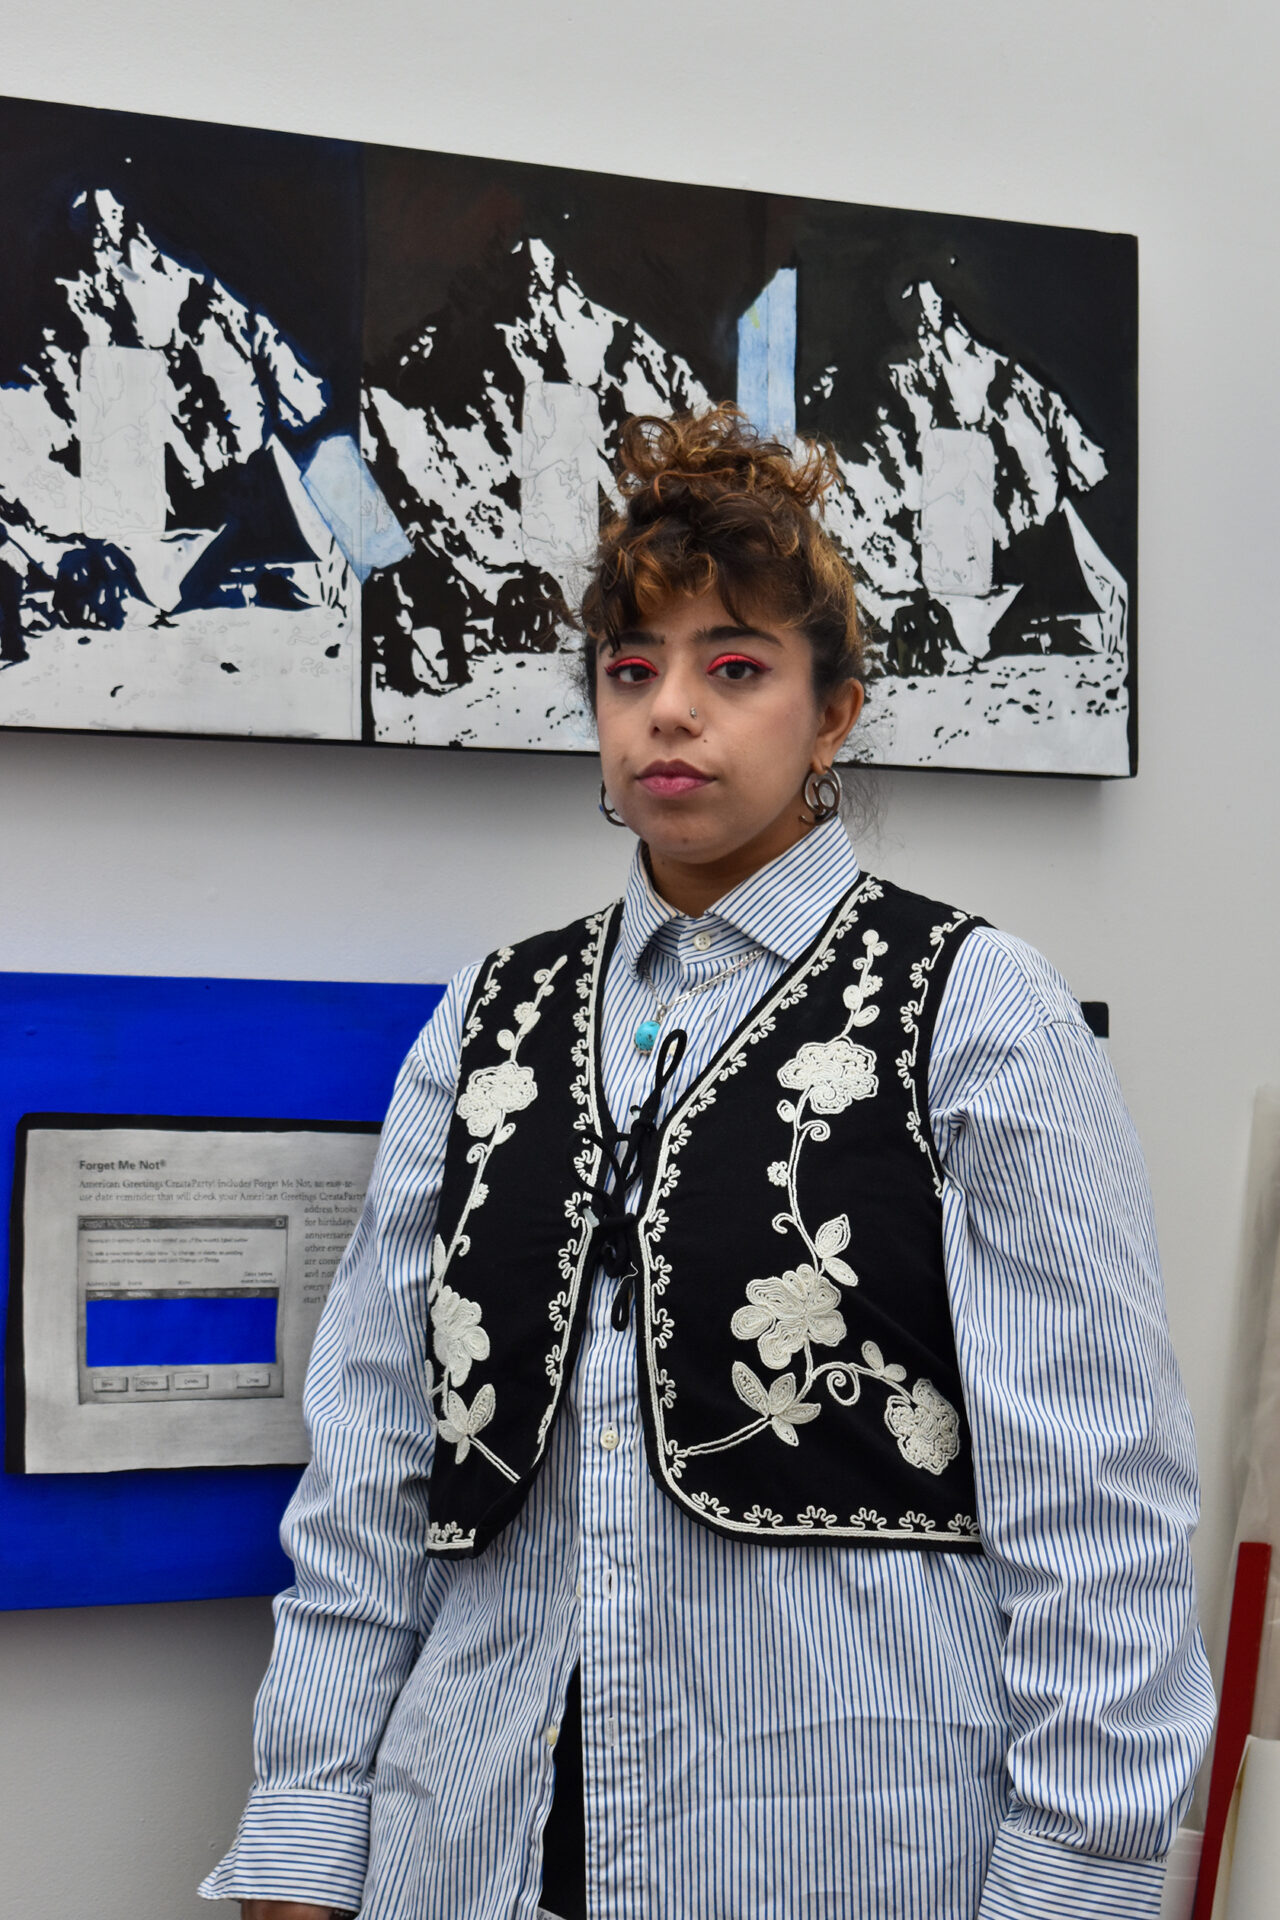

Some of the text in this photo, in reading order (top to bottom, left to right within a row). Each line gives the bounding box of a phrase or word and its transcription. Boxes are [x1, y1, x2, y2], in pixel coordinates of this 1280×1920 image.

[79, 1160, 115, 1172] Forget
[118, 1160, 136, 1170] Me
[79, 1180, 120, 1188] American
[122, 1180, 163, 1190] Greetings
[217, 1180, 252, 1189] includes
[253, 1180, 278, 1189] Forget
[281, 1180, 294, 1188] Me
[95, 1193, 113, 1201] date
[115, 1192, 155, 1201] reminder
[157, 1192, 174, 1201] that
[176, 1192, 191, 1201] will
[192, 1192, 217, 1201] check
[218, 1193, 238, 1202] your
[240, 1192, 278, 1201] American
[281, 1192, 317, 1202] Greetings
[304, 1204, 357, 1213] address books
[304, 1244, 325, 1252] other
[319, 1257, 341, 1265] comin
[304, 1270, 319, 1278] and
[303, 1296, 321, 1304] start
